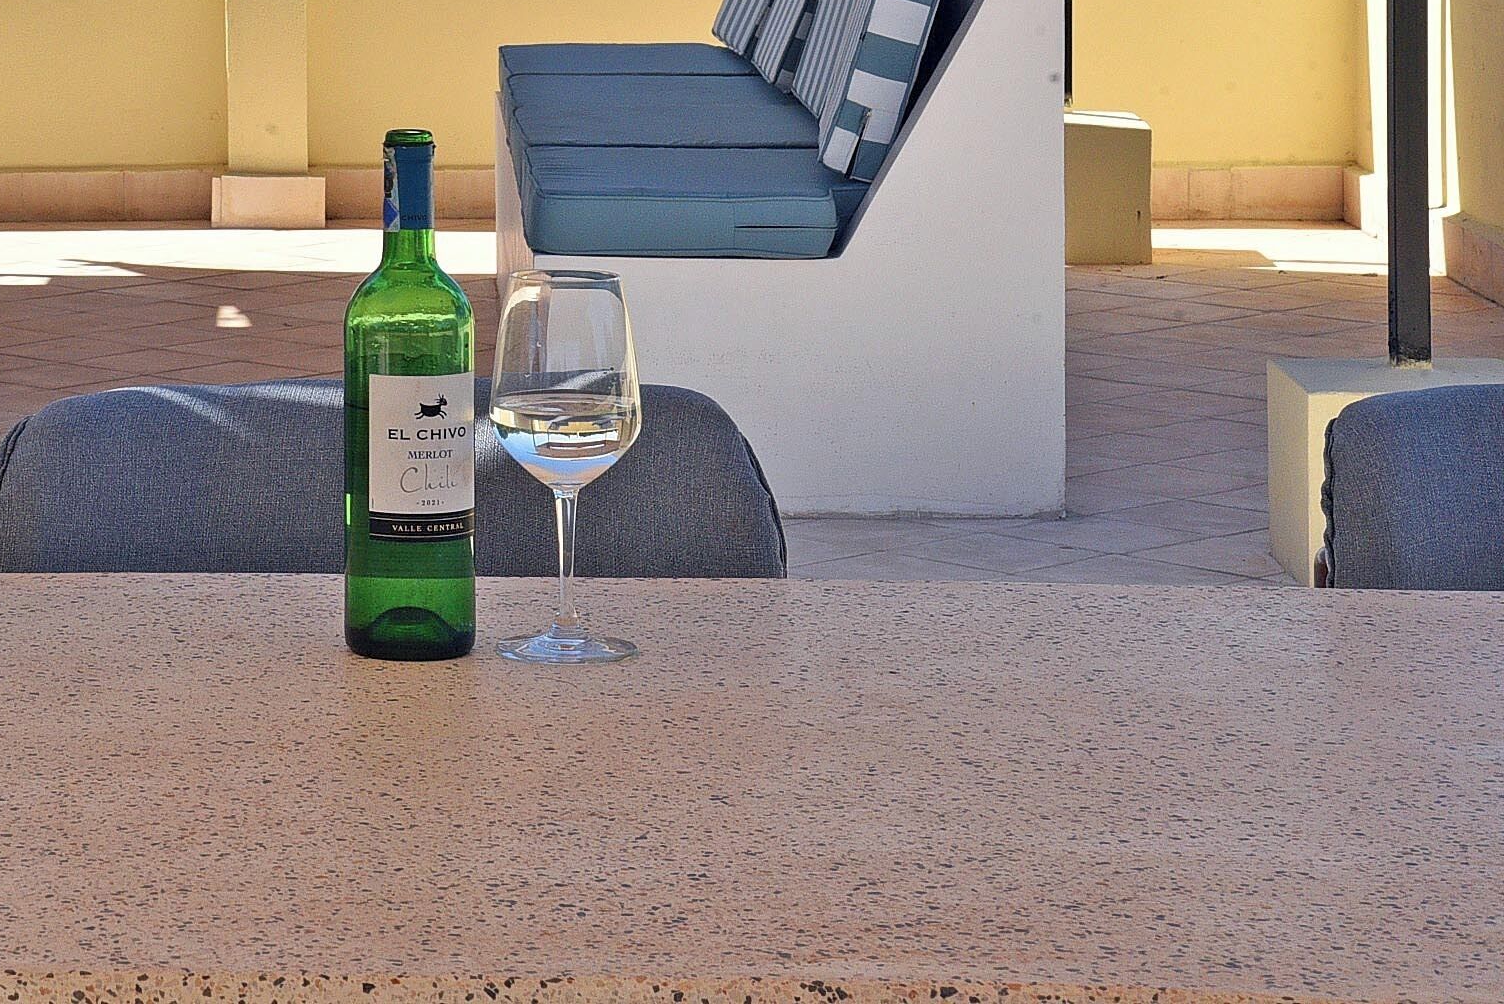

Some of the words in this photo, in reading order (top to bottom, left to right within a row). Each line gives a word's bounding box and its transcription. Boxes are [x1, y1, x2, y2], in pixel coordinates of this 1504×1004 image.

[388, 428, 411, 441] EL
[416, 426, 466, 441] CHIVO
[407, 449, 453, 460] MERLOT
[392, 524, 422, 533] VALLE
[426, 522, 465, 533] CENTRAL
